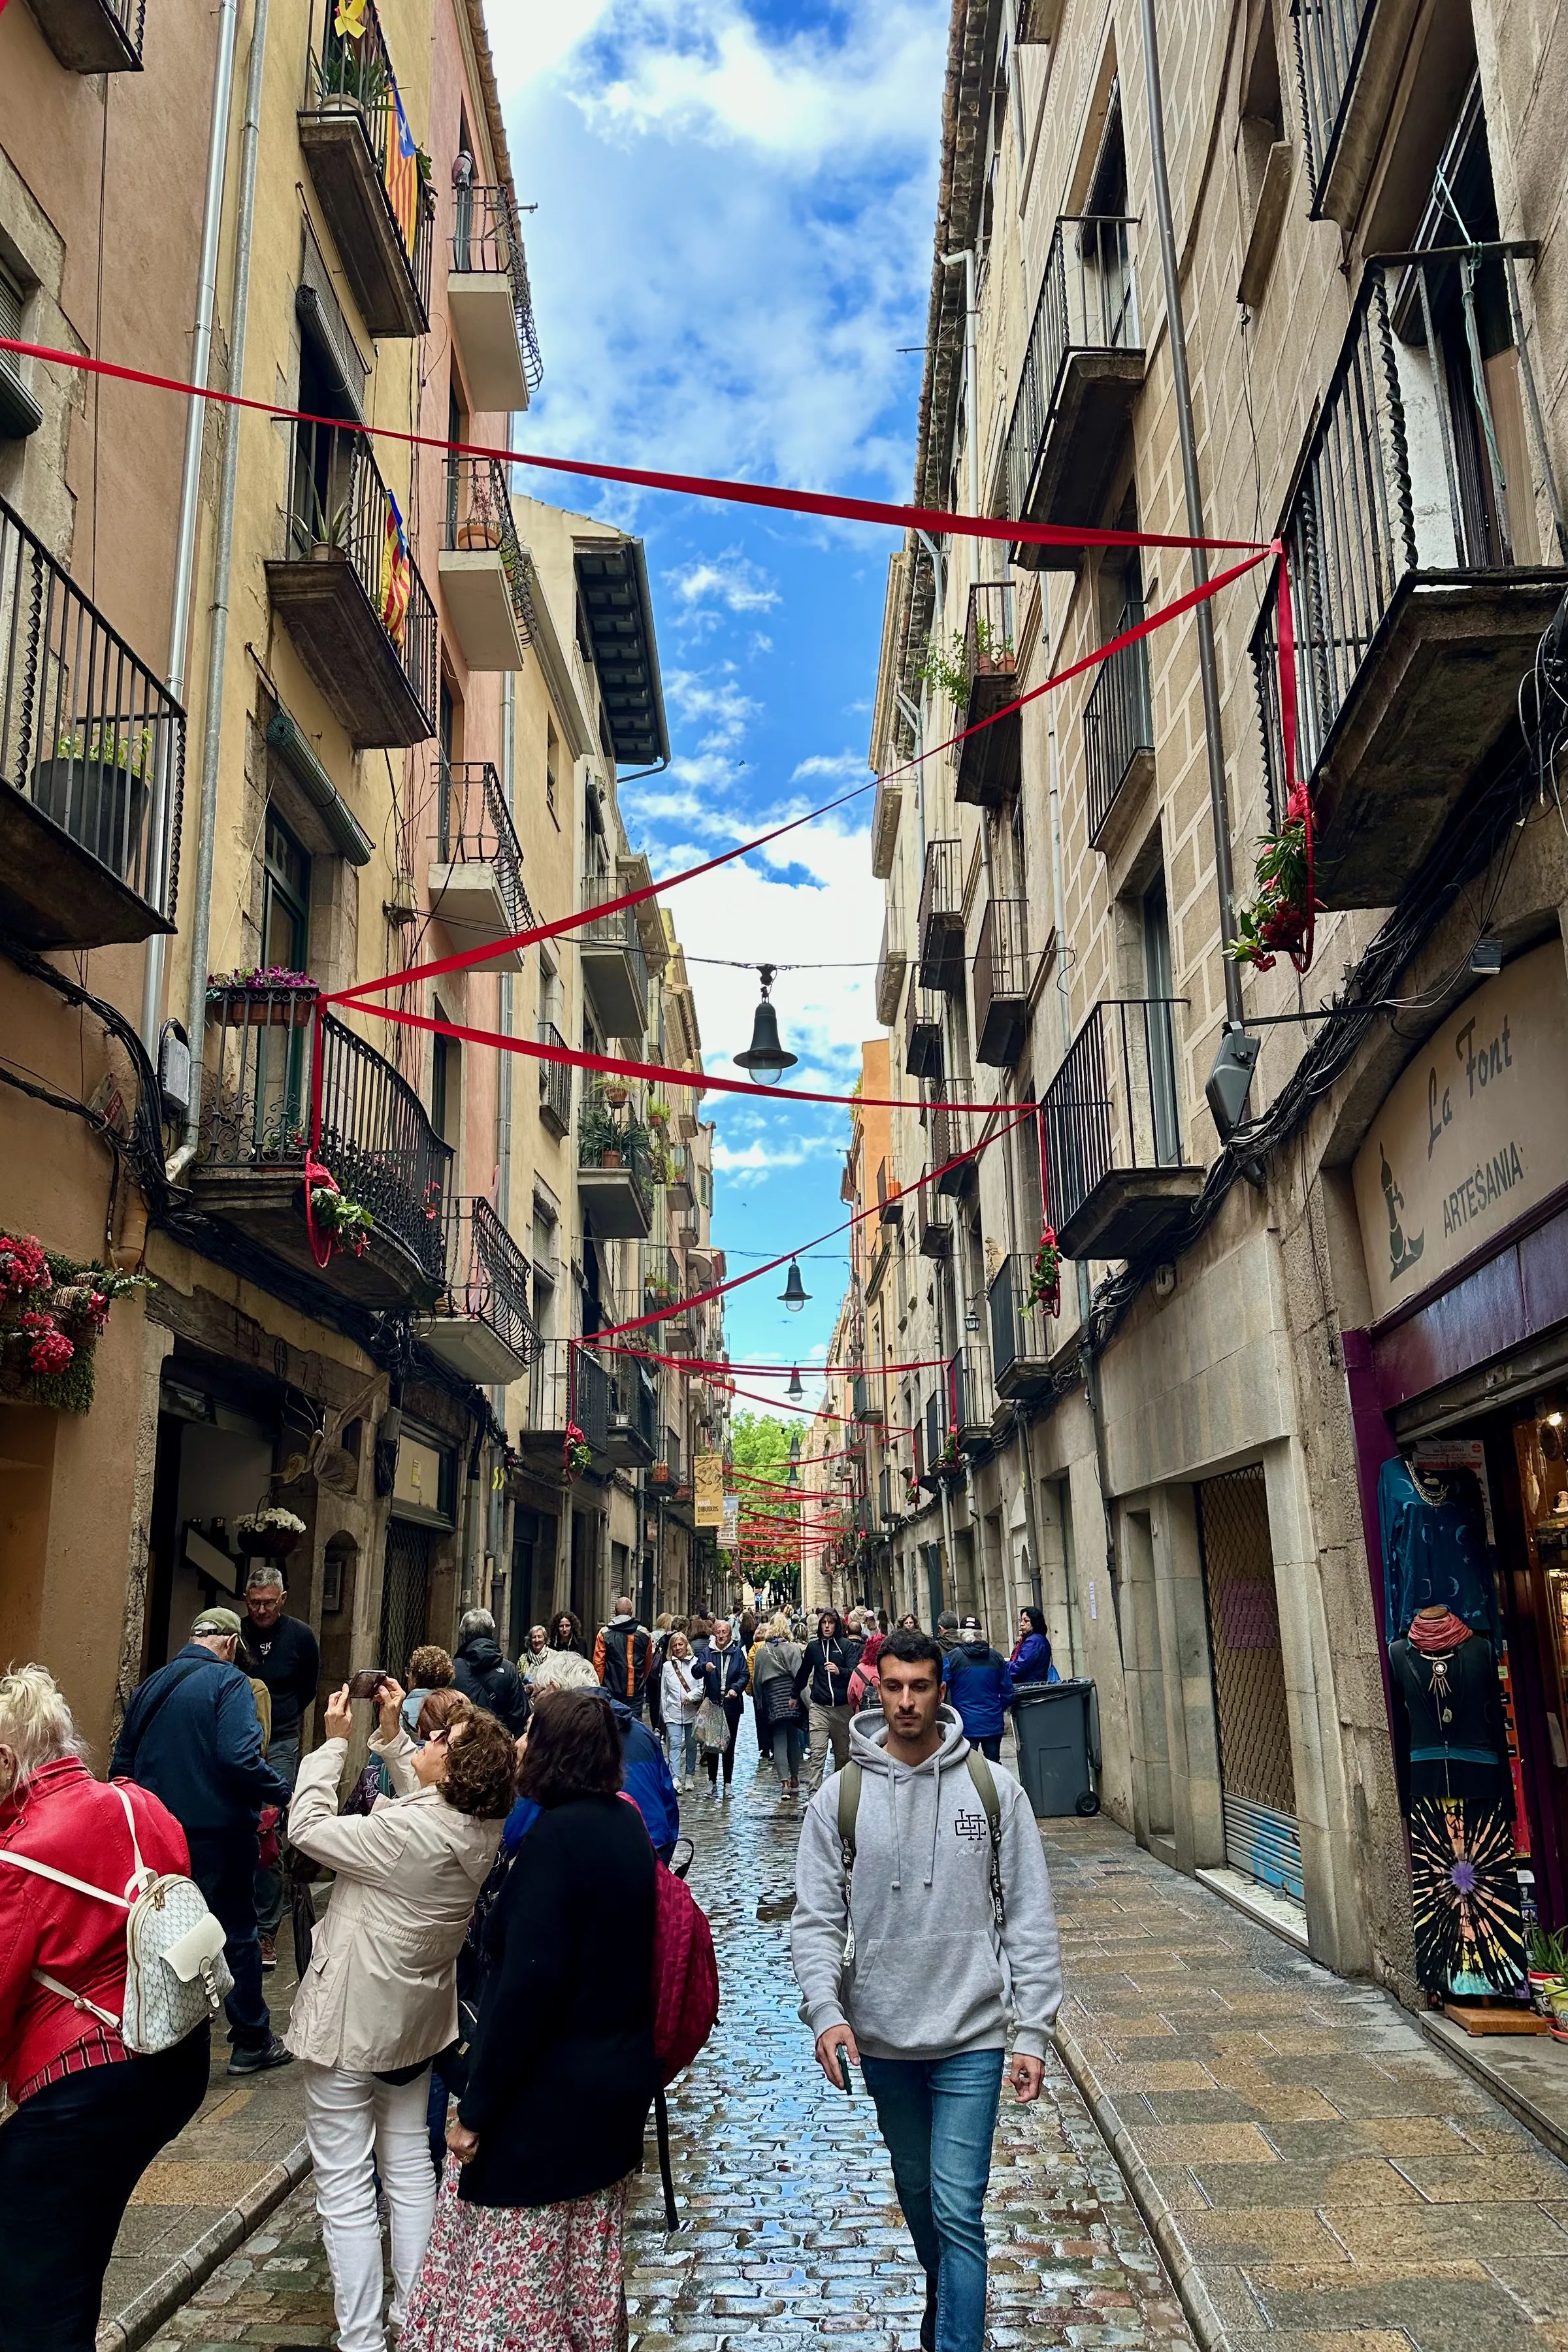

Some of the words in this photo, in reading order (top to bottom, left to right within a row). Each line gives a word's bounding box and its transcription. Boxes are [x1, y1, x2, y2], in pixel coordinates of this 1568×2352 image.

[1428, 1066, 1452, 1162] La
[1456, 1014, 1512, 1100] Font
[1443, 1141, 1524, 1238] ARTESANIA
